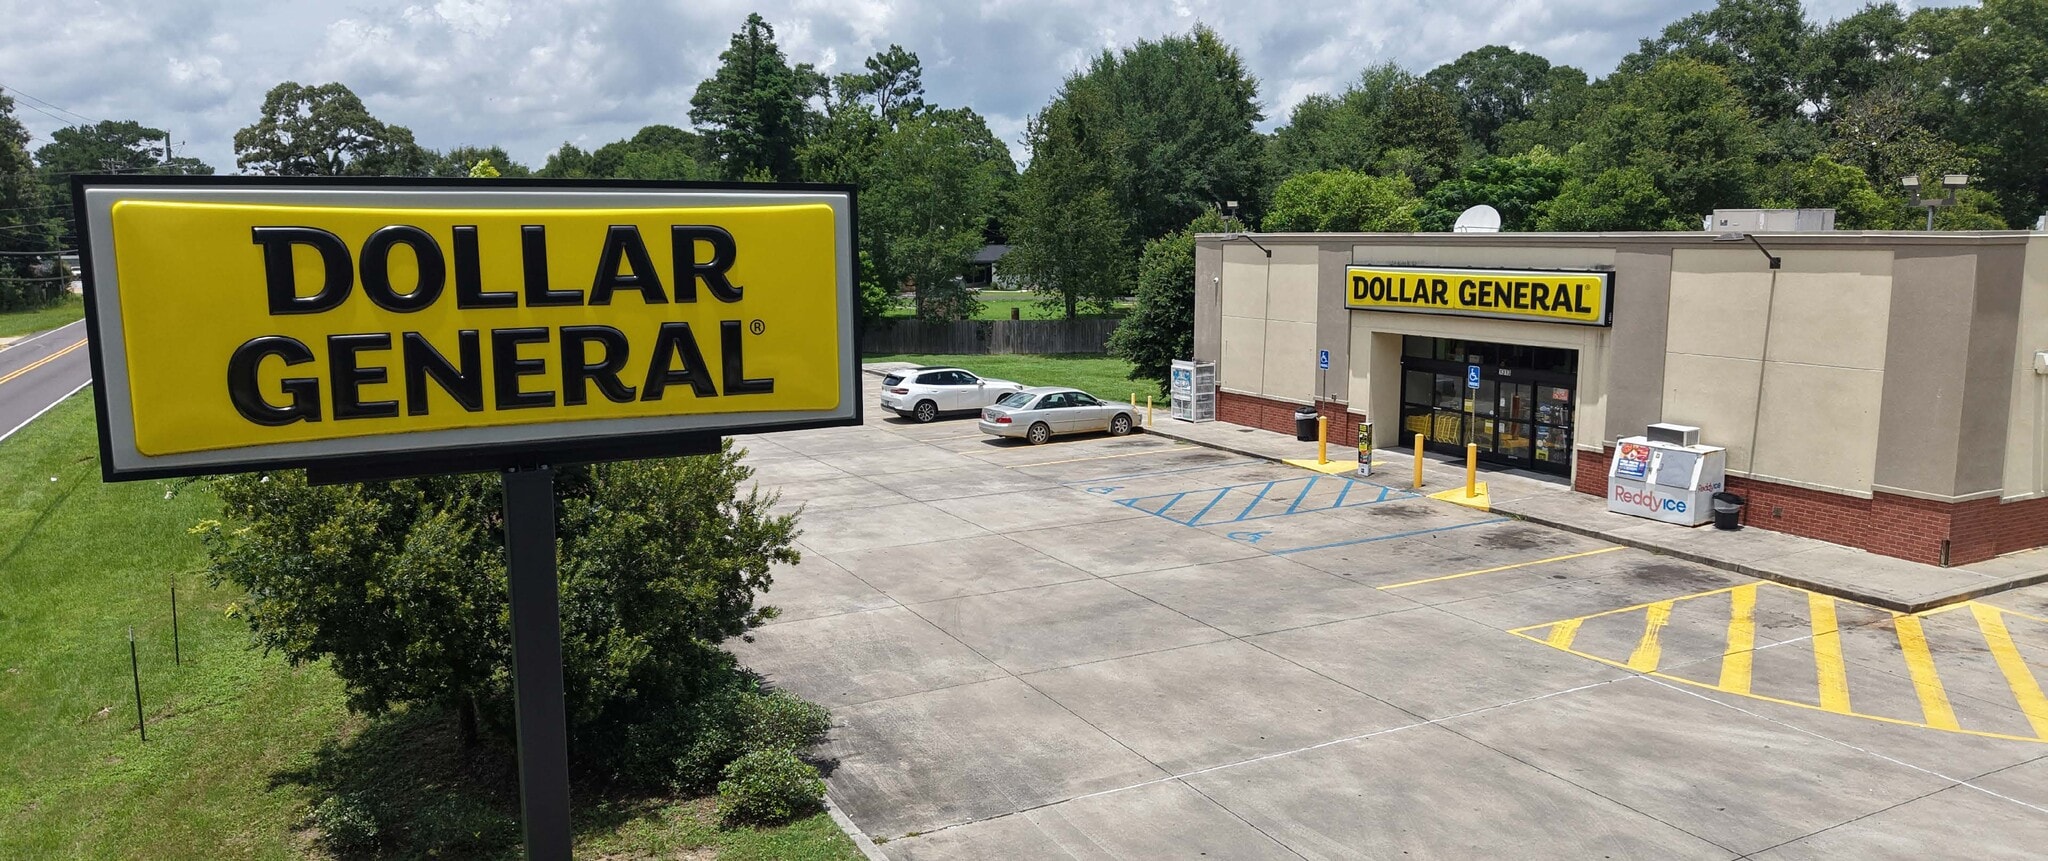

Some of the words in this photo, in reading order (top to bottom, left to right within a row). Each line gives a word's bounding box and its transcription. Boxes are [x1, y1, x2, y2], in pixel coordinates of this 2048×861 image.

[251, 225, 744, 316] DOLLAR
[1352, 275, 1449, 306] DOLLAR
[1615, 485, 1662, 512] Reddy
